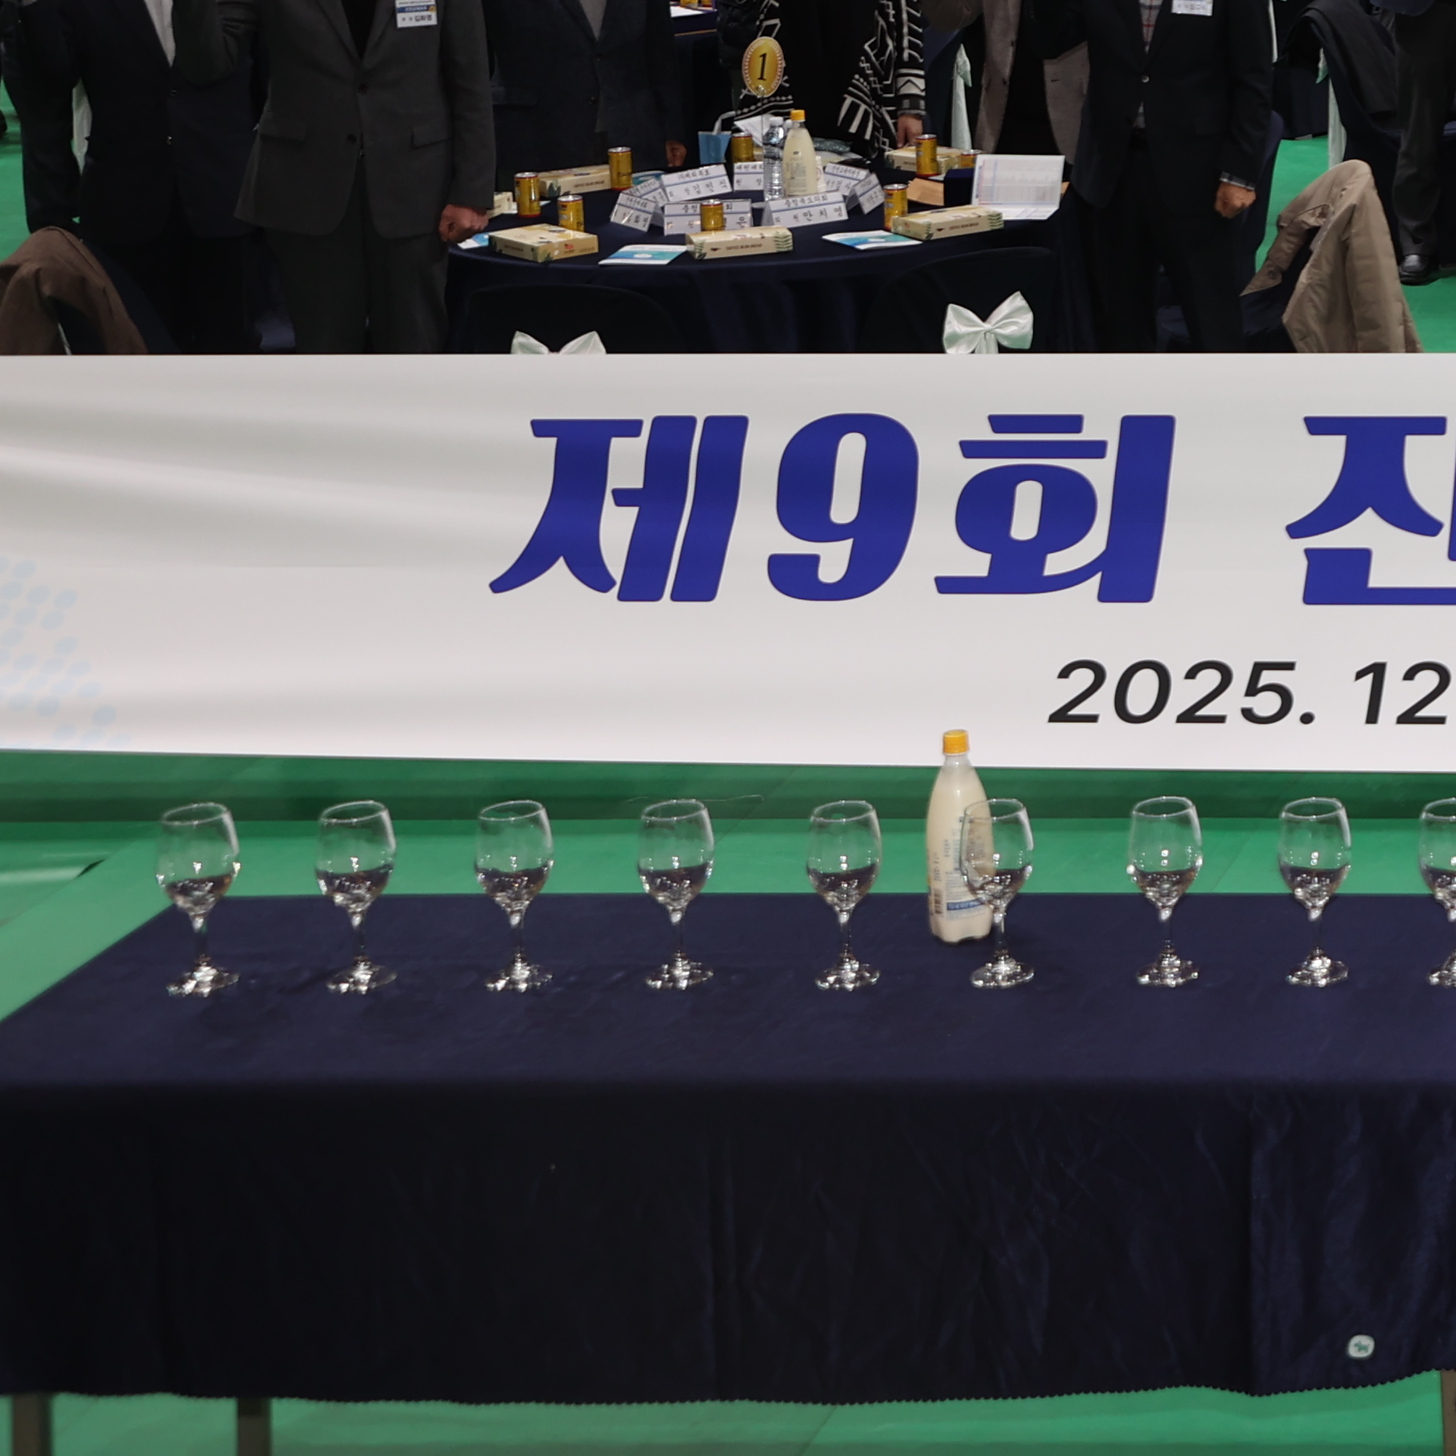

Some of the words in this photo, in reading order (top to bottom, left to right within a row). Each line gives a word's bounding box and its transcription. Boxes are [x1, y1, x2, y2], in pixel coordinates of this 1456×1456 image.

[757, 53, 767, 81] 1
[490, 414, 1174, 602] 제9회
[1047, 660, 1314, 725] 2025.
